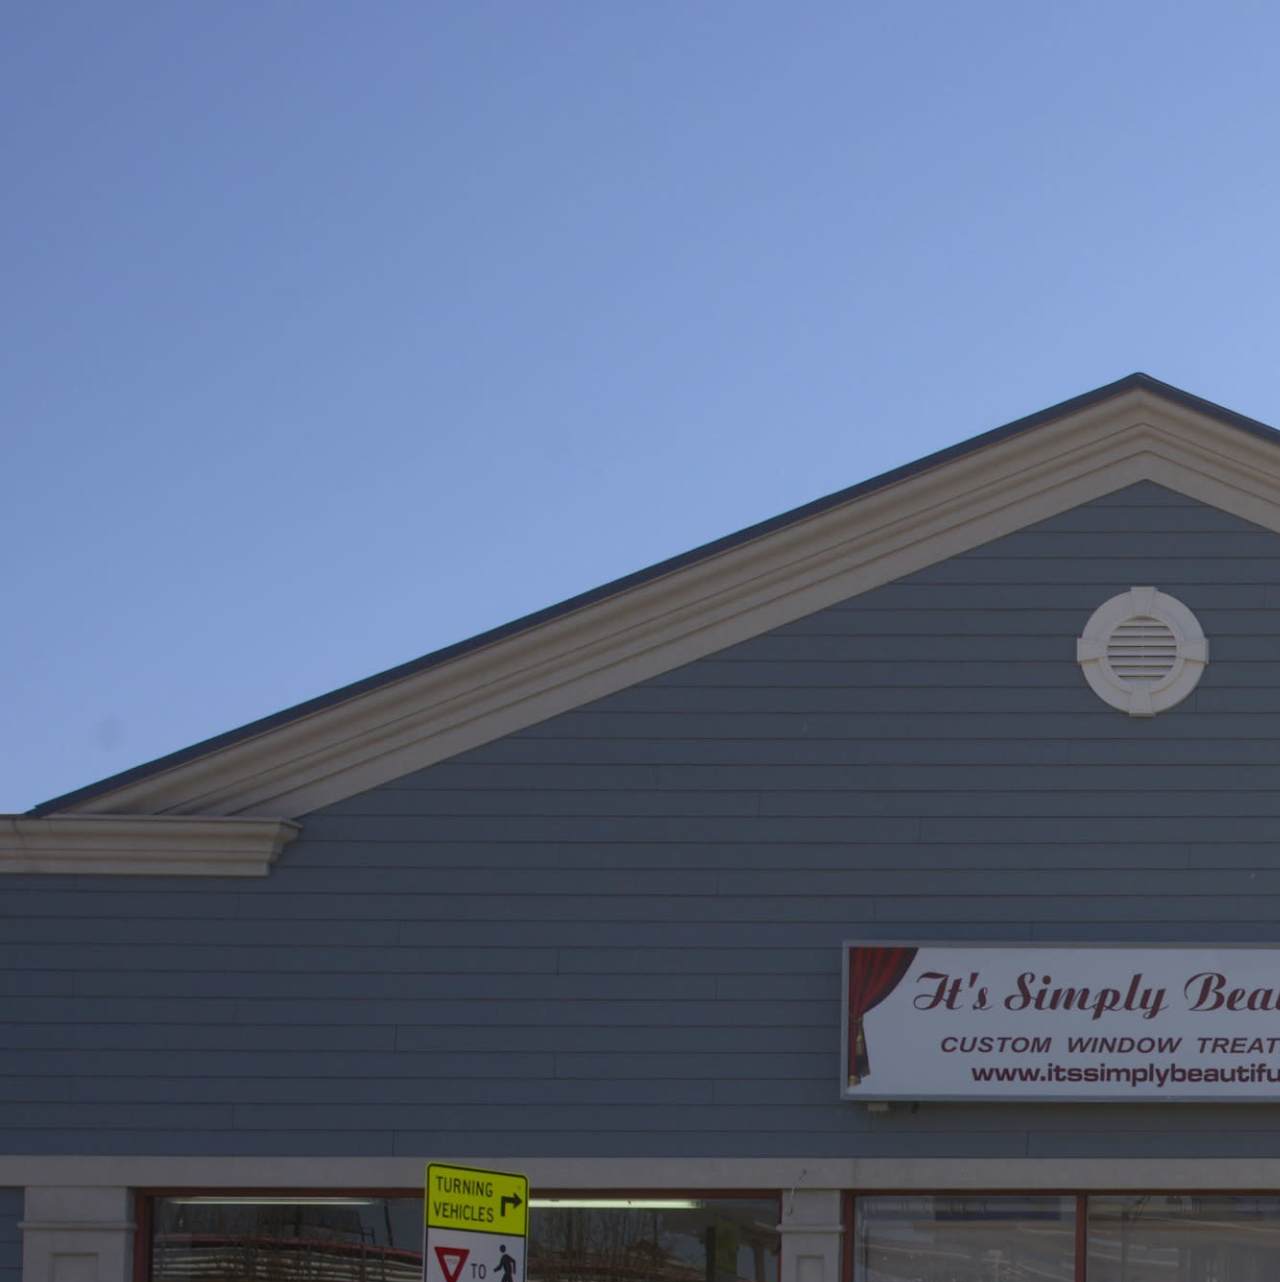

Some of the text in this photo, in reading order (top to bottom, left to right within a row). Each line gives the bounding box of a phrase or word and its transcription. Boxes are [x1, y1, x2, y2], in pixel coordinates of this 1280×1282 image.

[913, 971, 994, 1012] It's
[1003, 972, 1171, 1020] Simply
[940, 1036, 1052, 1055] CUSTOM
[1067, 1036, 1183, 1055] WINDOW
[435, 1176, 494, 1197] TURNING
[433, 1201, 495, 1223] VEHICLES
[471, 1263, 487, 1280] TO
